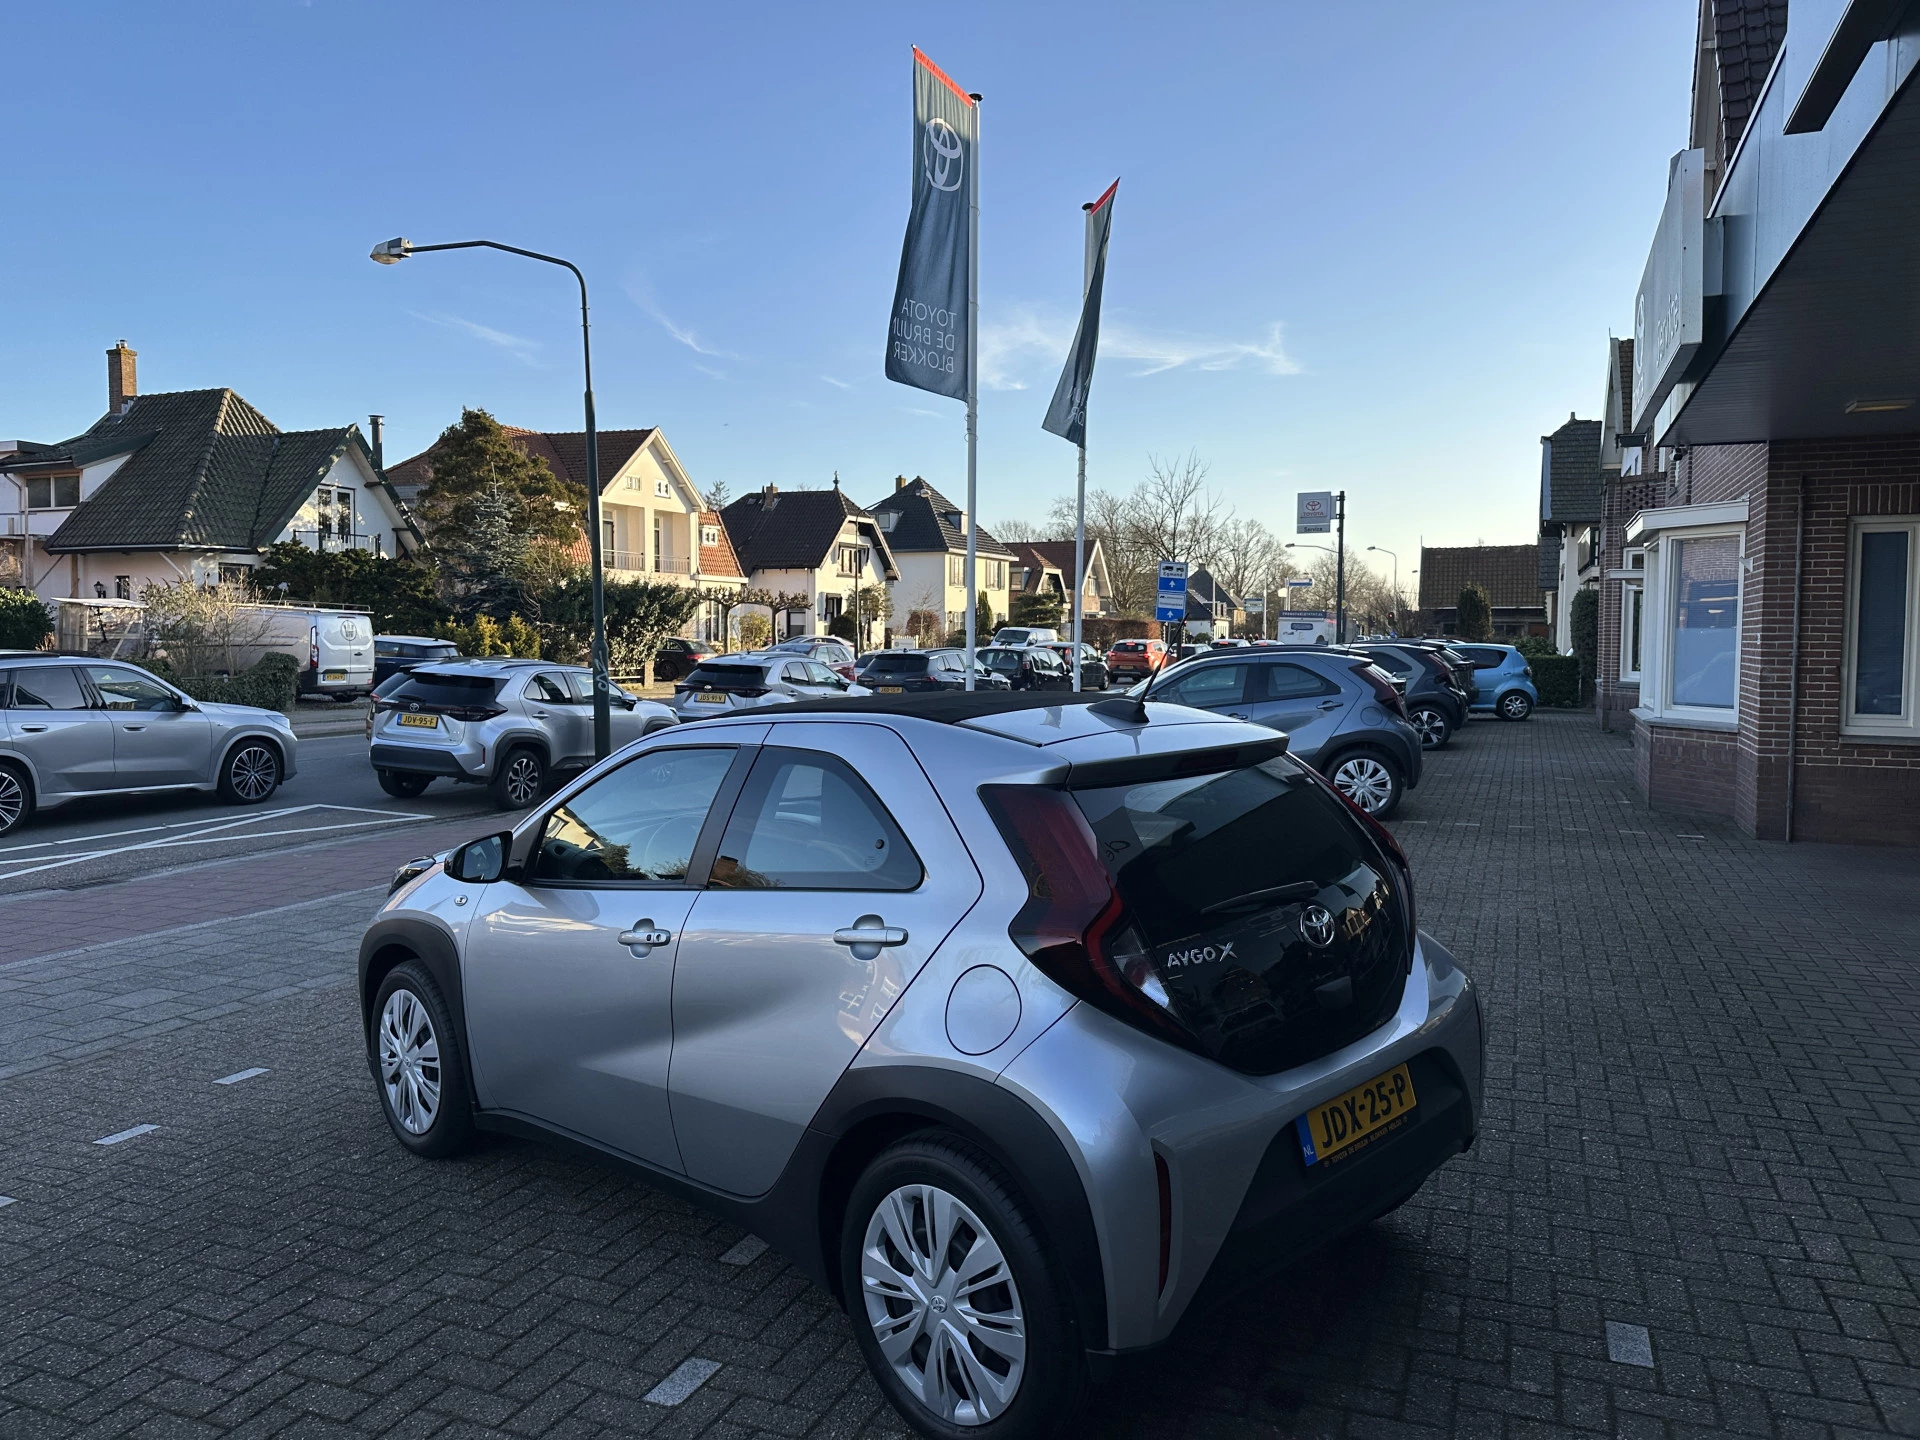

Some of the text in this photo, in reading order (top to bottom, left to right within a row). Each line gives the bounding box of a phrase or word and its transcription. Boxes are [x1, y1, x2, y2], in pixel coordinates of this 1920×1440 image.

[403, 715, 435, 726] JDV-95-F
[1167, 941, 1238, 969] AYGO X
[1321, 1073, 1406, 1149] JDX-25-P
[1303, 1144, 1314, 1157] NL
